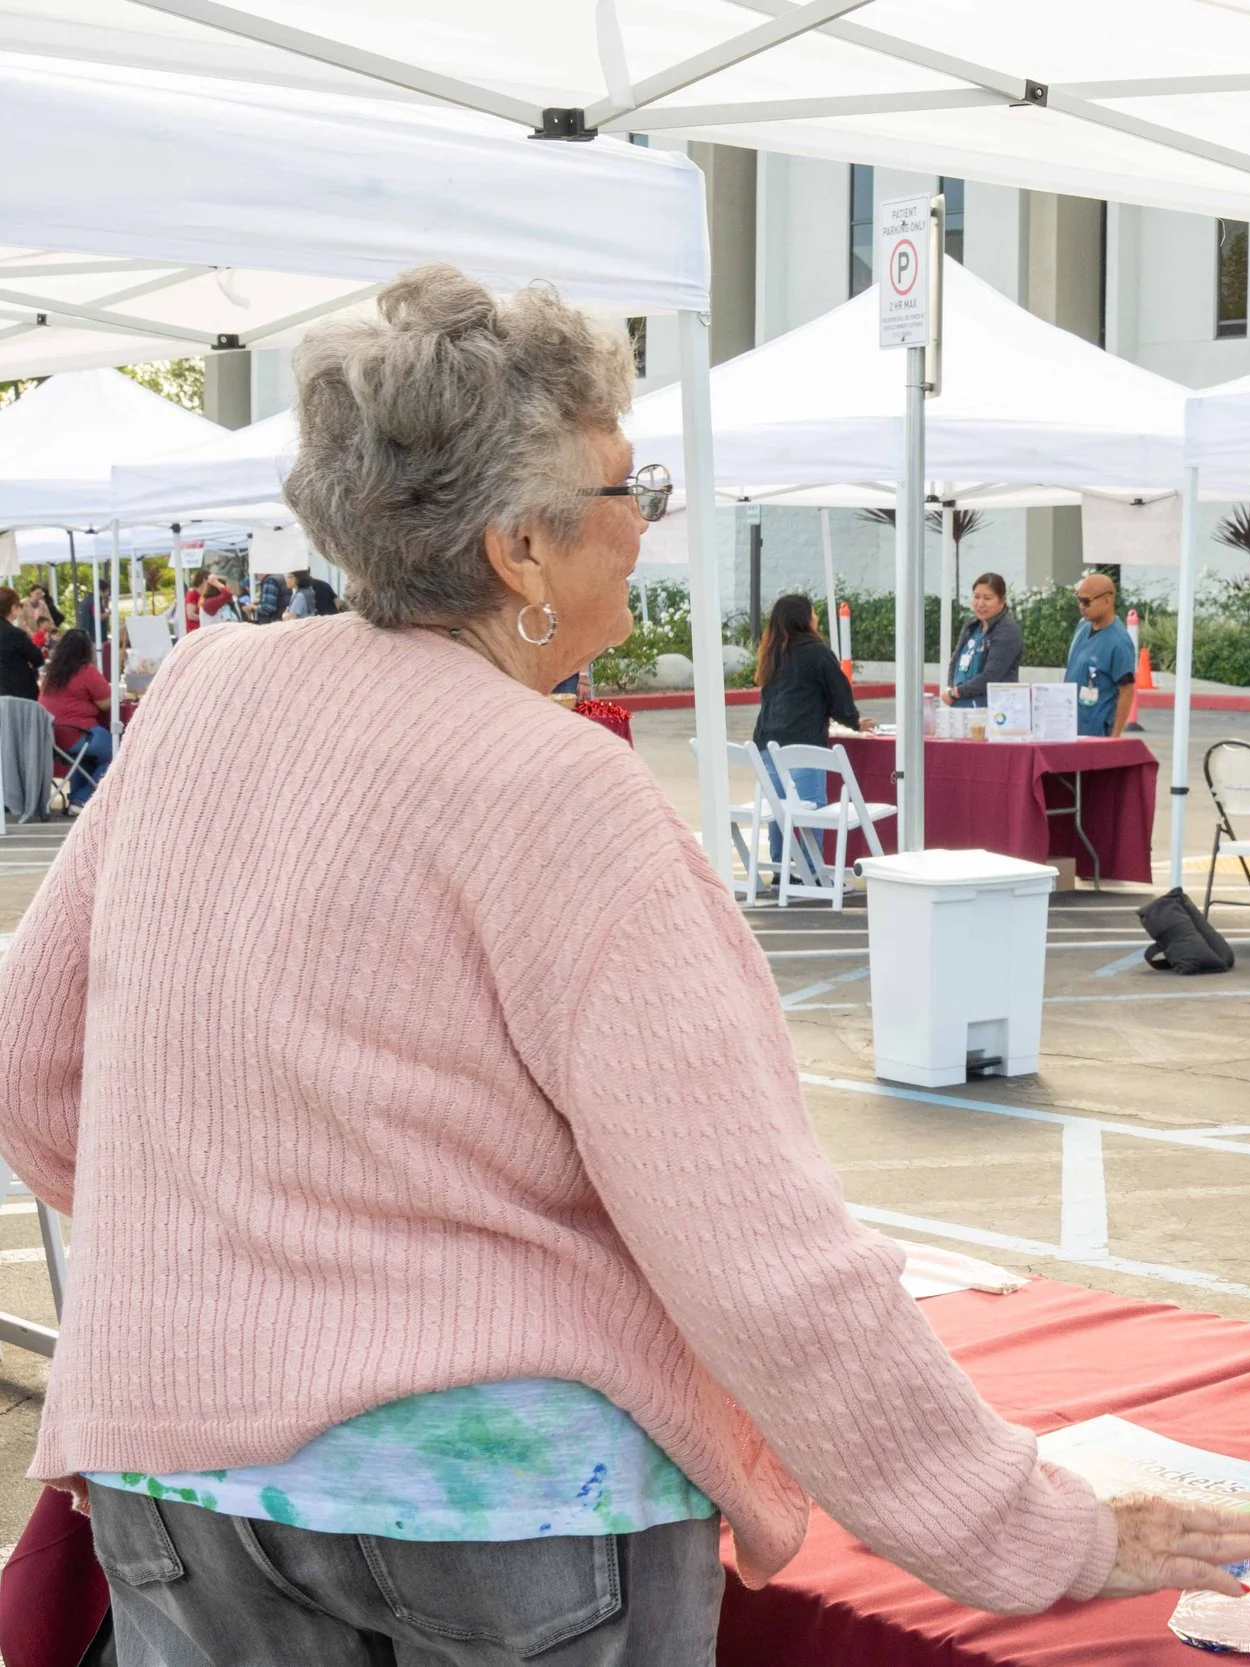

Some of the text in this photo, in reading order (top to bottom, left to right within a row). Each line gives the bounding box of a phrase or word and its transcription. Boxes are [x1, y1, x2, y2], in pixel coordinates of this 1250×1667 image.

[892, 206, 917, 219] PATIENT
[883, 221, 926, 236] PARKING ONLY
